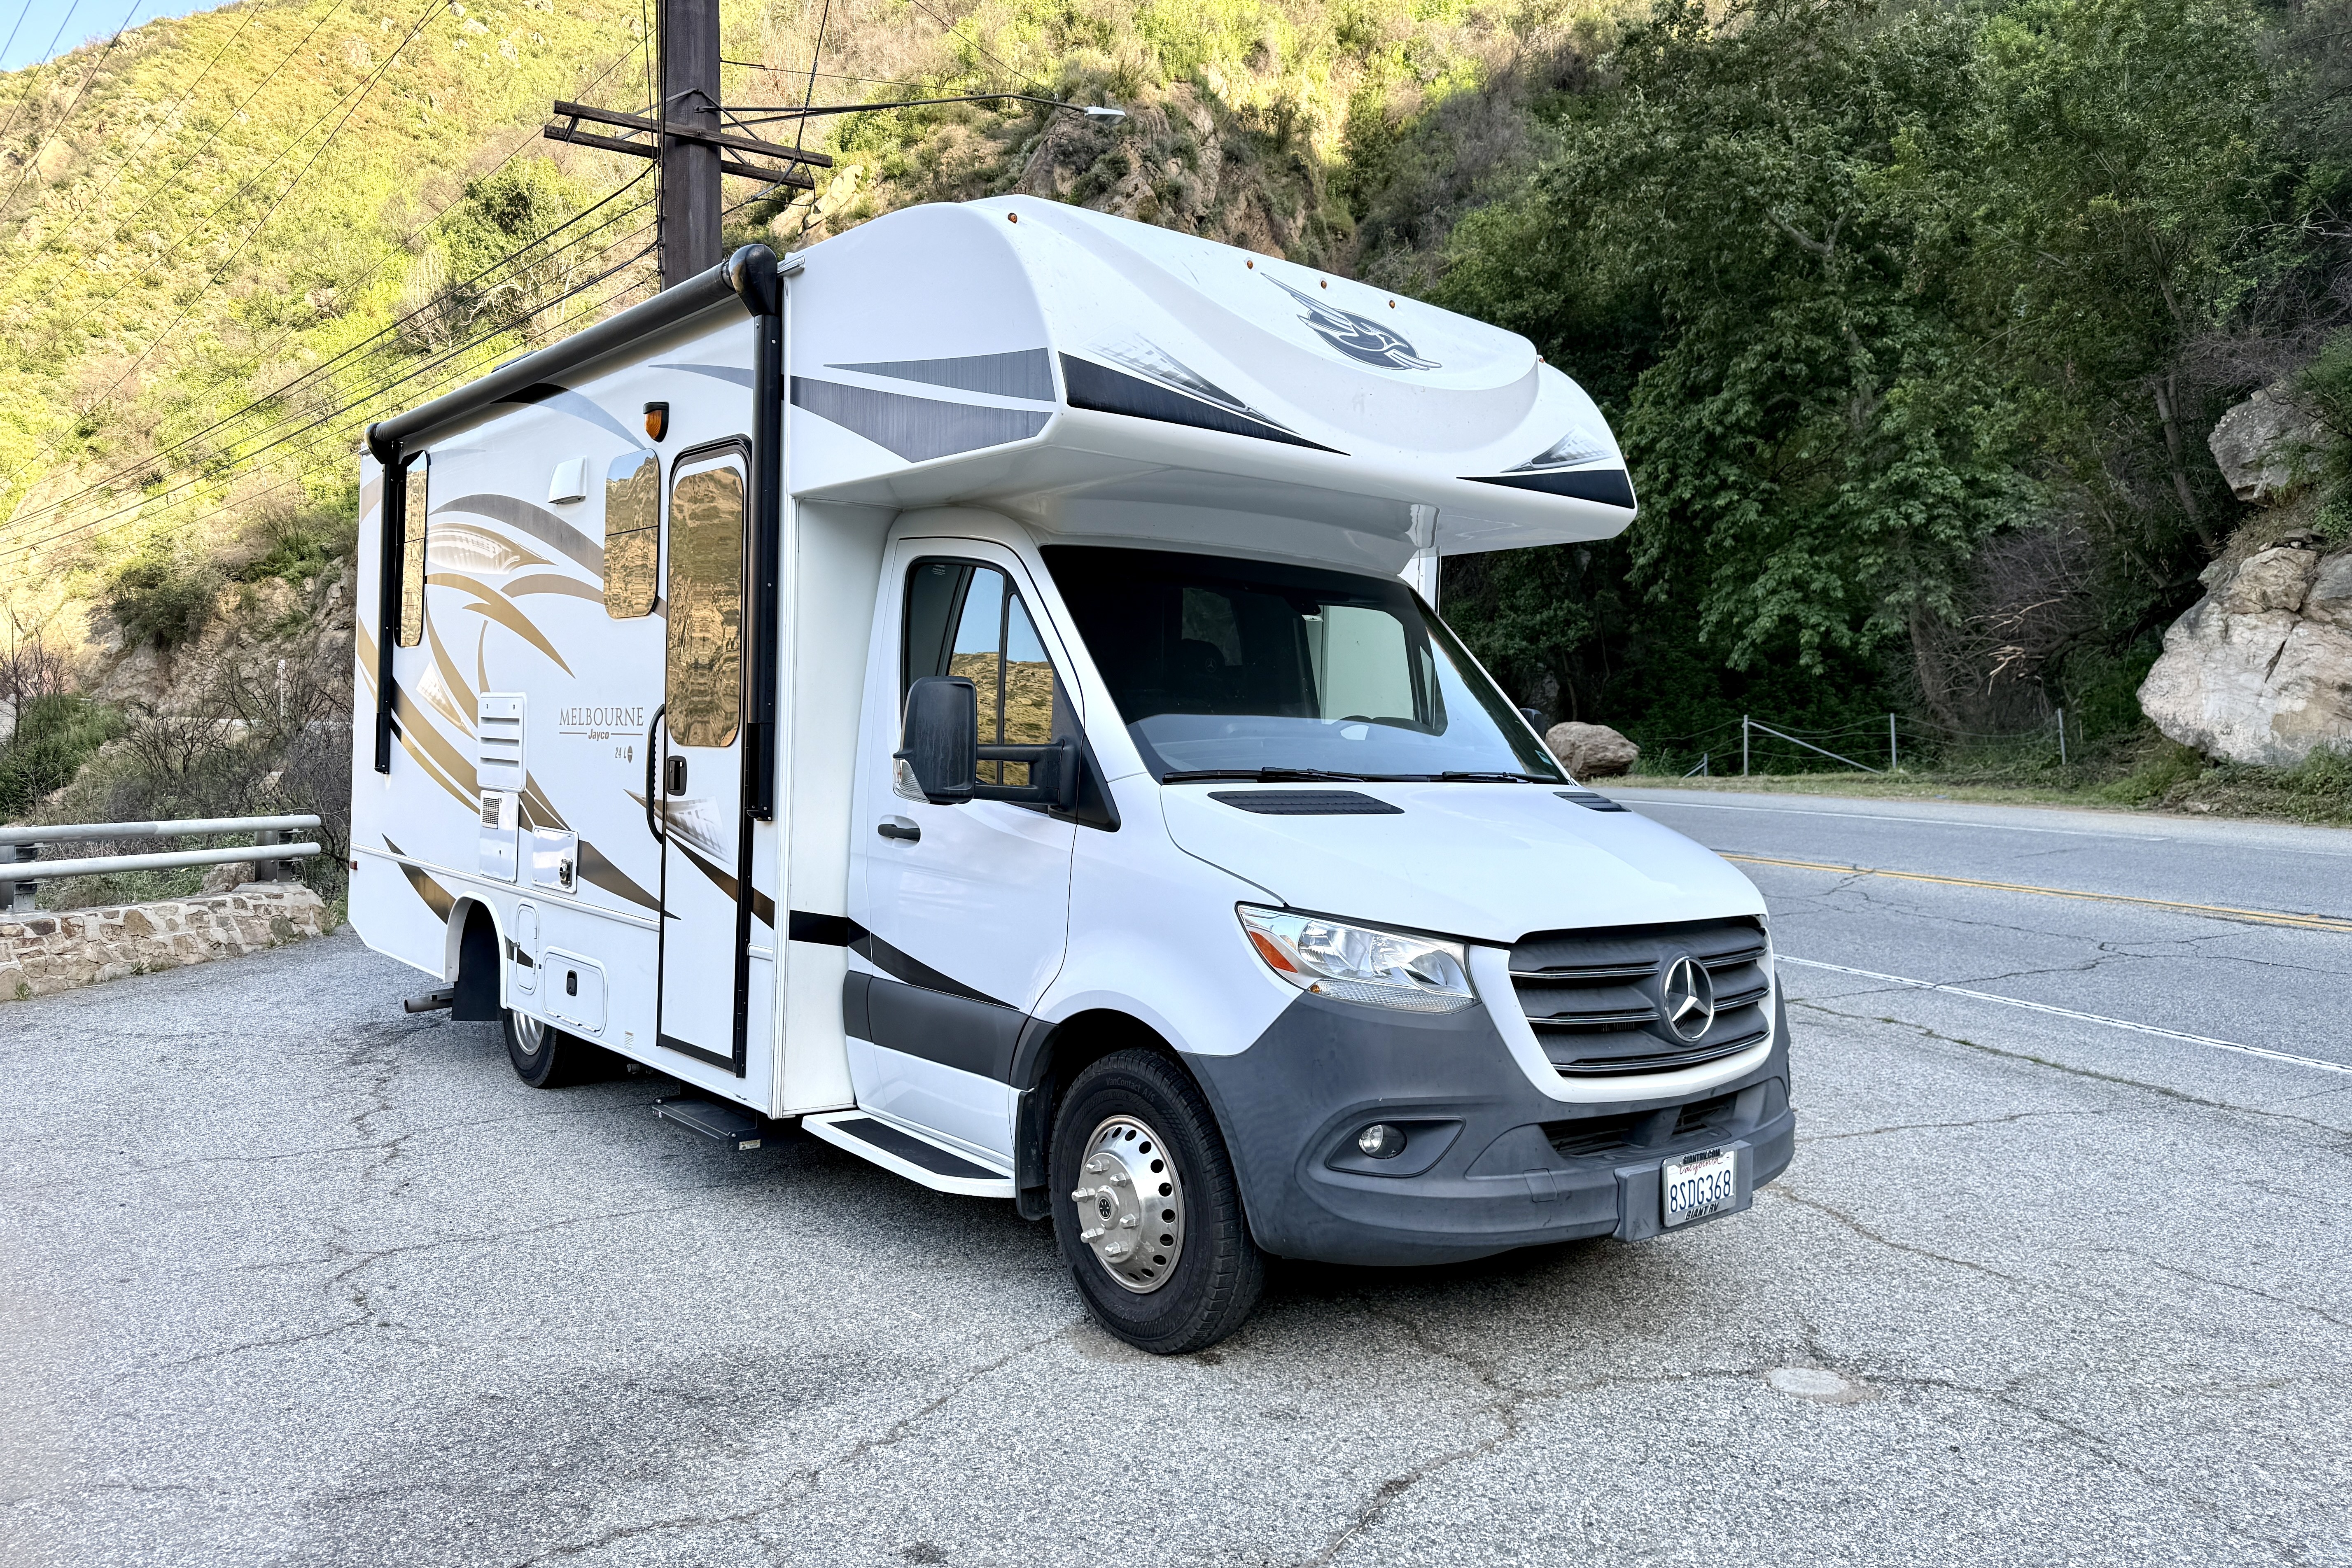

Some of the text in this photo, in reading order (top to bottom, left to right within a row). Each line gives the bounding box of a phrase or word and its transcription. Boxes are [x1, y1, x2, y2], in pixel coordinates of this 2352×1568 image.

[559, 707, 644, 726] MELBOURNE
[588, 728, 609, 741] Jayco
[1106, 1077, 1156, 1103] VanContact A/S
[1683, 1148, 1720, 1164] GIANTRV.COM
[1670, 1169, 1731, 1213] 8SDG368
[1685, 1202, 1720, 1220] GIANT RV
